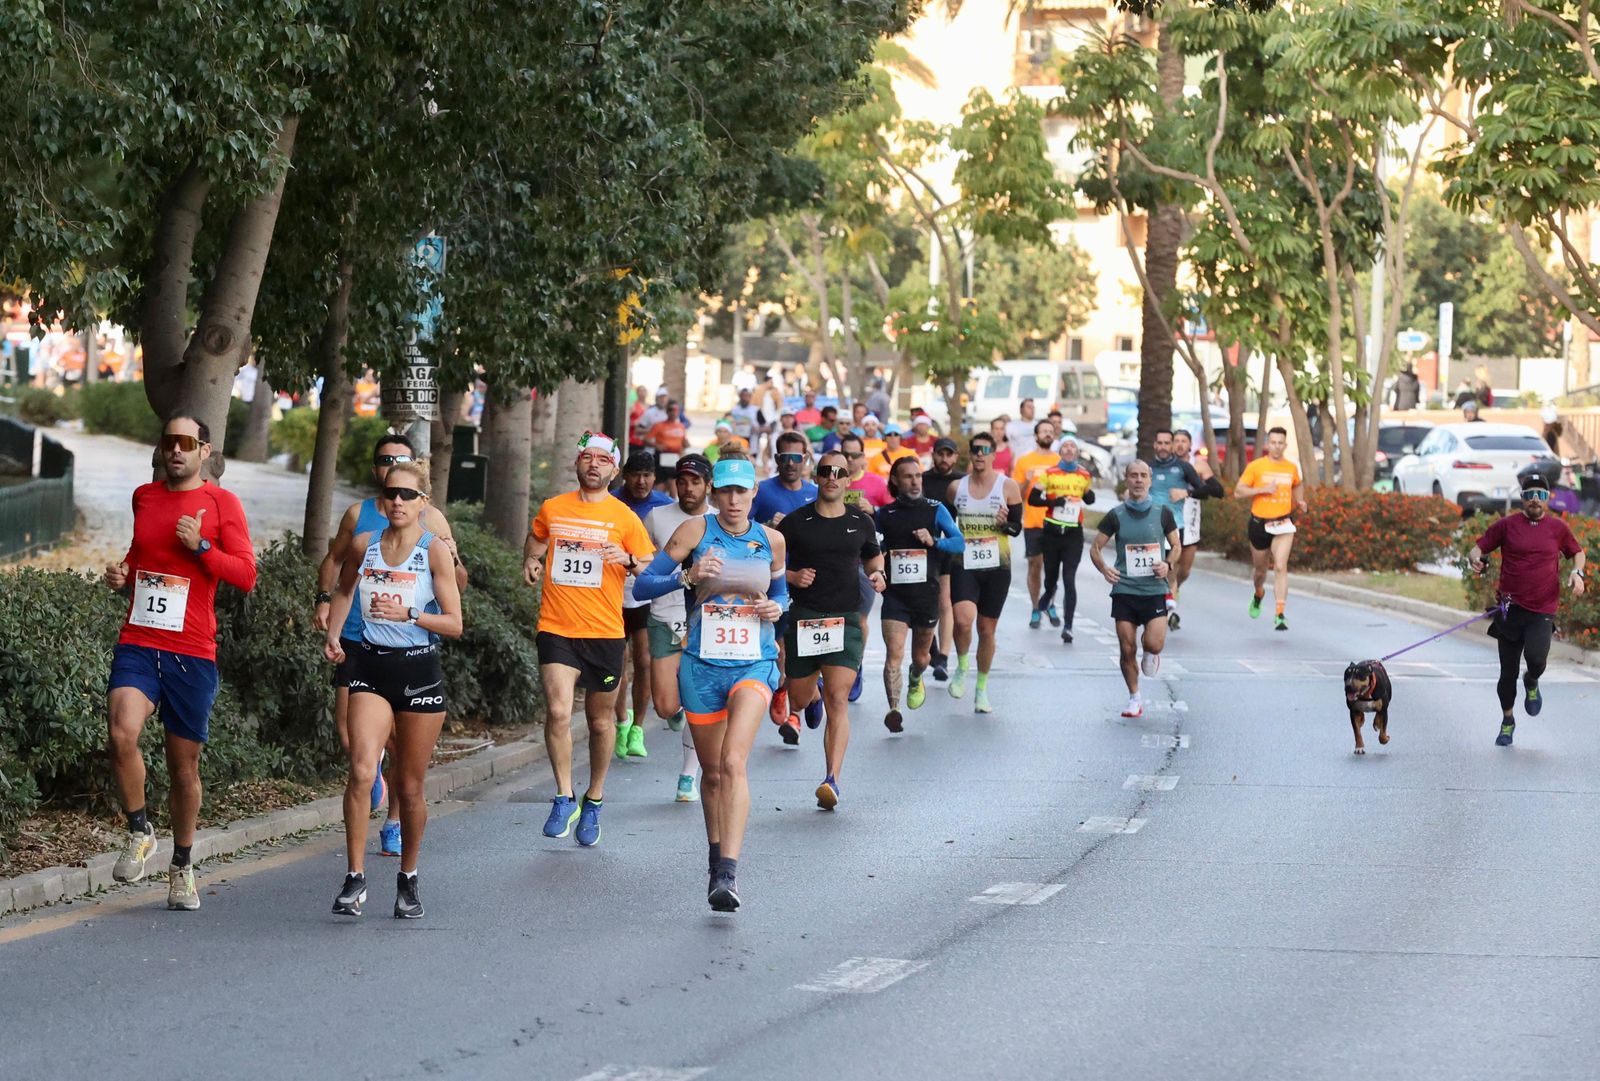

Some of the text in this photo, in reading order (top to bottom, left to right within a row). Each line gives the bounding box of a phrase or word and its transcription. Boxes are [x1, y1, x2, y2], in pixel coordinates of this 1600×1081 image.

[406, 390, 414, 402] 5
[417, 390, 437, 402] DIC
[971, 549, 993, 560] 363
[562, 558, 592, 575] 319
[897, 562, 919, 575] 563
[1134, 557, 1154, 568] 213
[146, 595, 168, 614] 15
[714, 627, 749, 645] 313
[812, 632, 830, 645] 94
[410, 695, 443, 707] PRO
